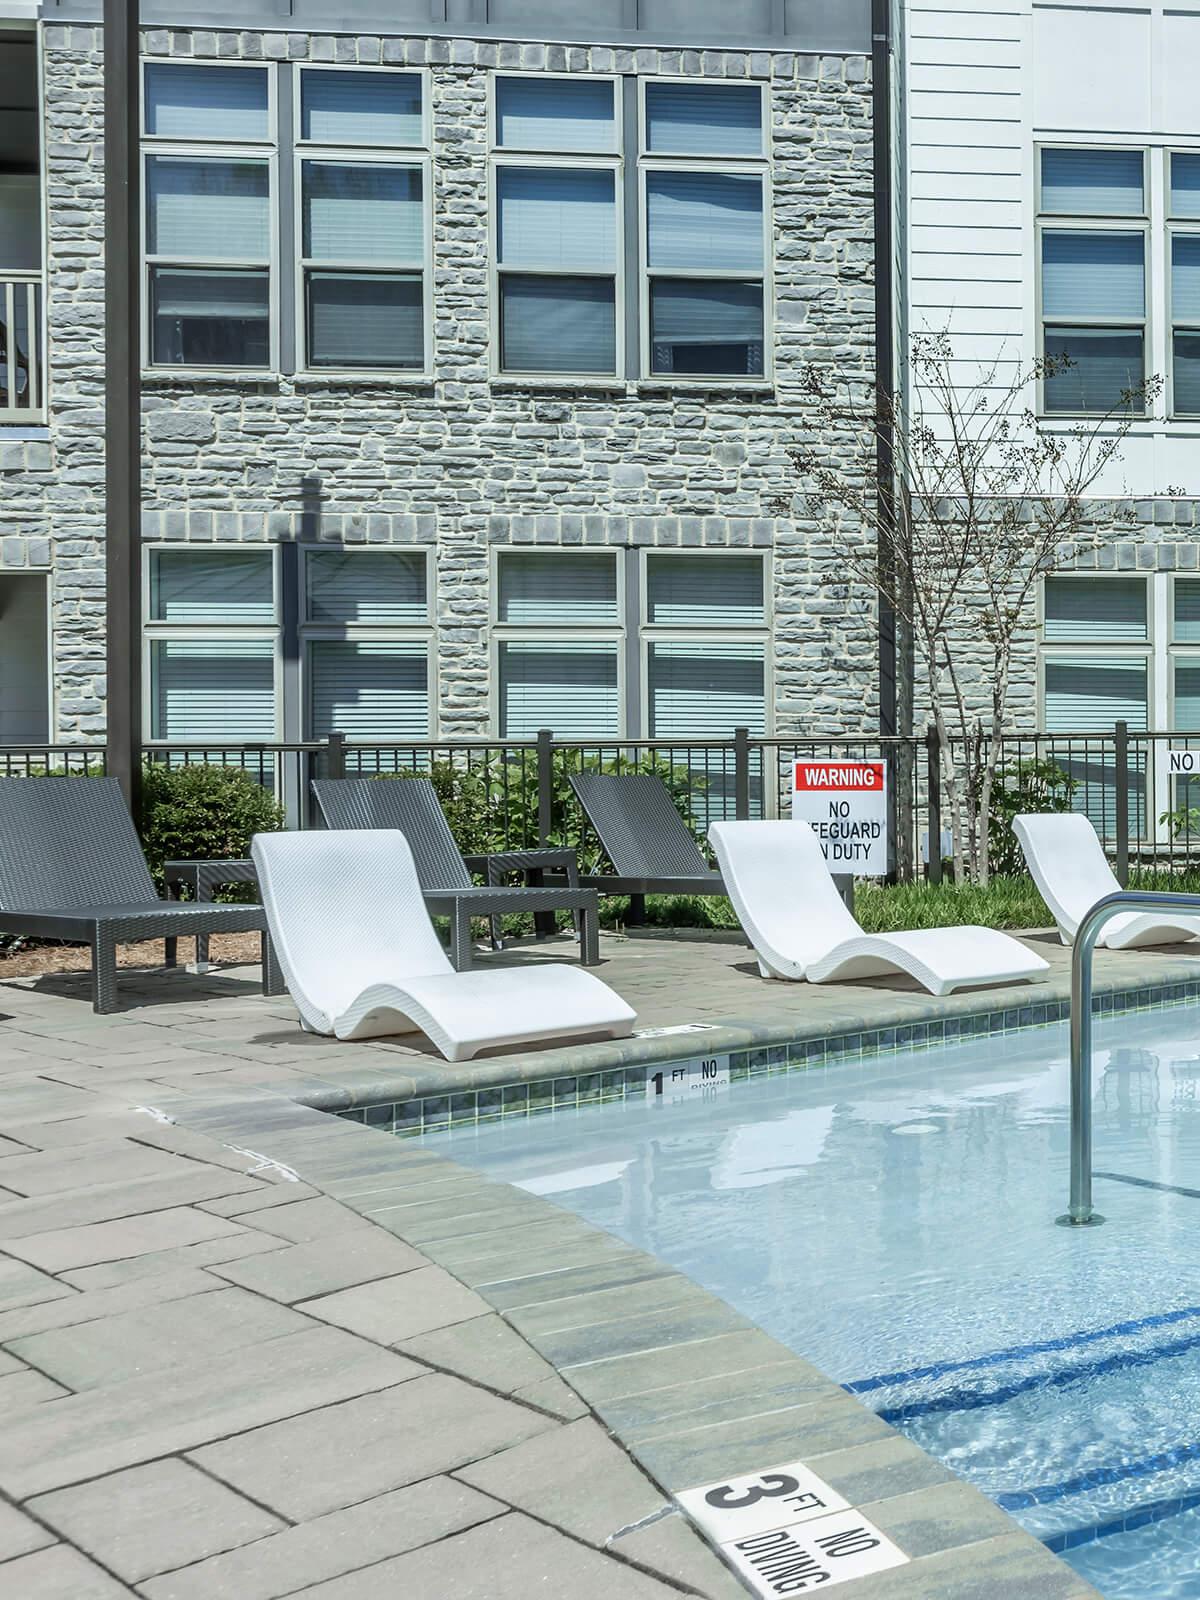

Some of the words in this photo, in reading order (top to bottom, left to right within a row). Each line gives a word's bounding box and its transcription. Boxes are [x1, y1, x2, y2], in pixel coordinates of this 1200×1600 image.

[1170, 753, 1194, 771] NO
[804, 768, 875, 786] WARNING
[829, 801, 850, 818] NO
[808, 822, 880, 838] FEGUARD
[820, 843, 828, 859] N
[833, 843, 872, 859] DUTY
[702, 1060, 717, 1079] NO
[651, 1072, 663, 1095] 1
[672, 1069, 685, 1082] FT
[705, 1474, 800, 1509] 3
[783, 1493, 827, 1512] FT
[814, 1527, 881, 1558] NO
[734, 1531, 831, 1594] DIVING
